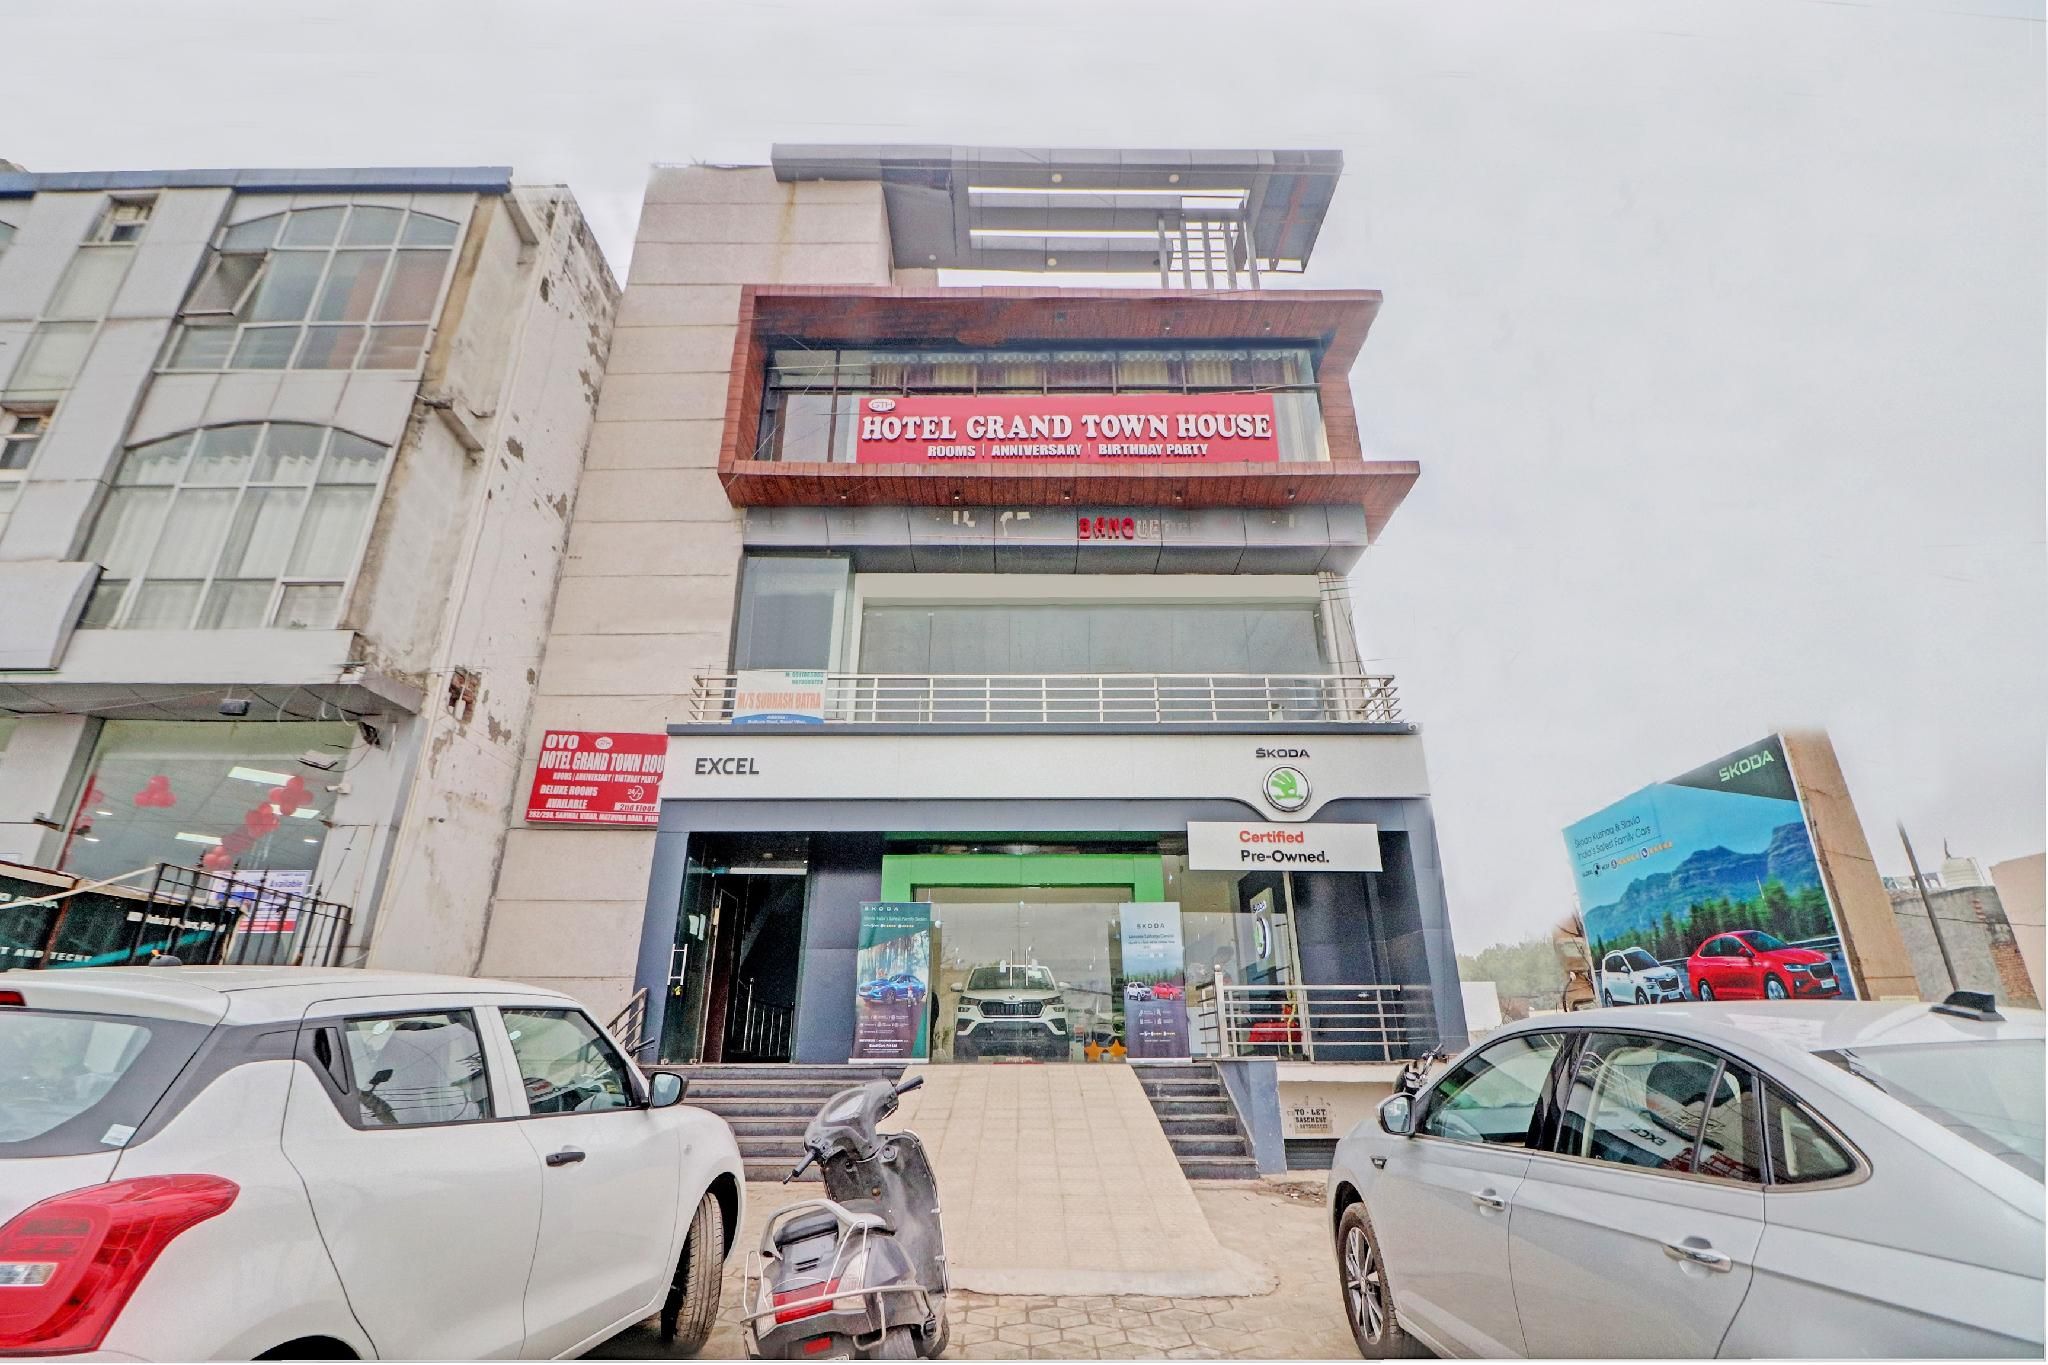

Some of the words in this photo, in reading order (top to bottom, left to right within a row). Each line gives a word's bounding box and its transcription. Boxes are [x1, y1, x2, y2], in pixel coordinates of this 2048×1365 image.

[871, 401, 893, 410] GTH
[862, 416, 957, 440] HOTEL
[966, 415, 1073, 440] GRAND
[1081, 414, 1169, 439] TOWN
[1176, 413, 1272, 438] HOUSE
[927, 445, 976, 458] ROOMS
[991, 444, 1082, 458] ANNIVERSARY
[1098, 443, 1163, 457] BIRTHDAY
[1165, 443, 1209, 457] PARTY
[545, 734, 579, 749] OYO
[539, 750, 572, 769] HOTEL
[572, 751, 610, 770] GRAND
[610, 753, 642, 772] TOWN
[695, 757, 760, 775] EXCEL
[640, 775, 658, 784] PARTY
[540, 784, 569, 795] DELUXE
[568, 785, 599, 796] ROOMS
[546, 798, 588, 809] AVAILABLE
[635, 804, 656, 812] Floor
[1239, 831, 1304, 843] Certified
[1635, 826, 1652, 838] Cars
[1241, 850, 1329, 863] Pre-Owned.
